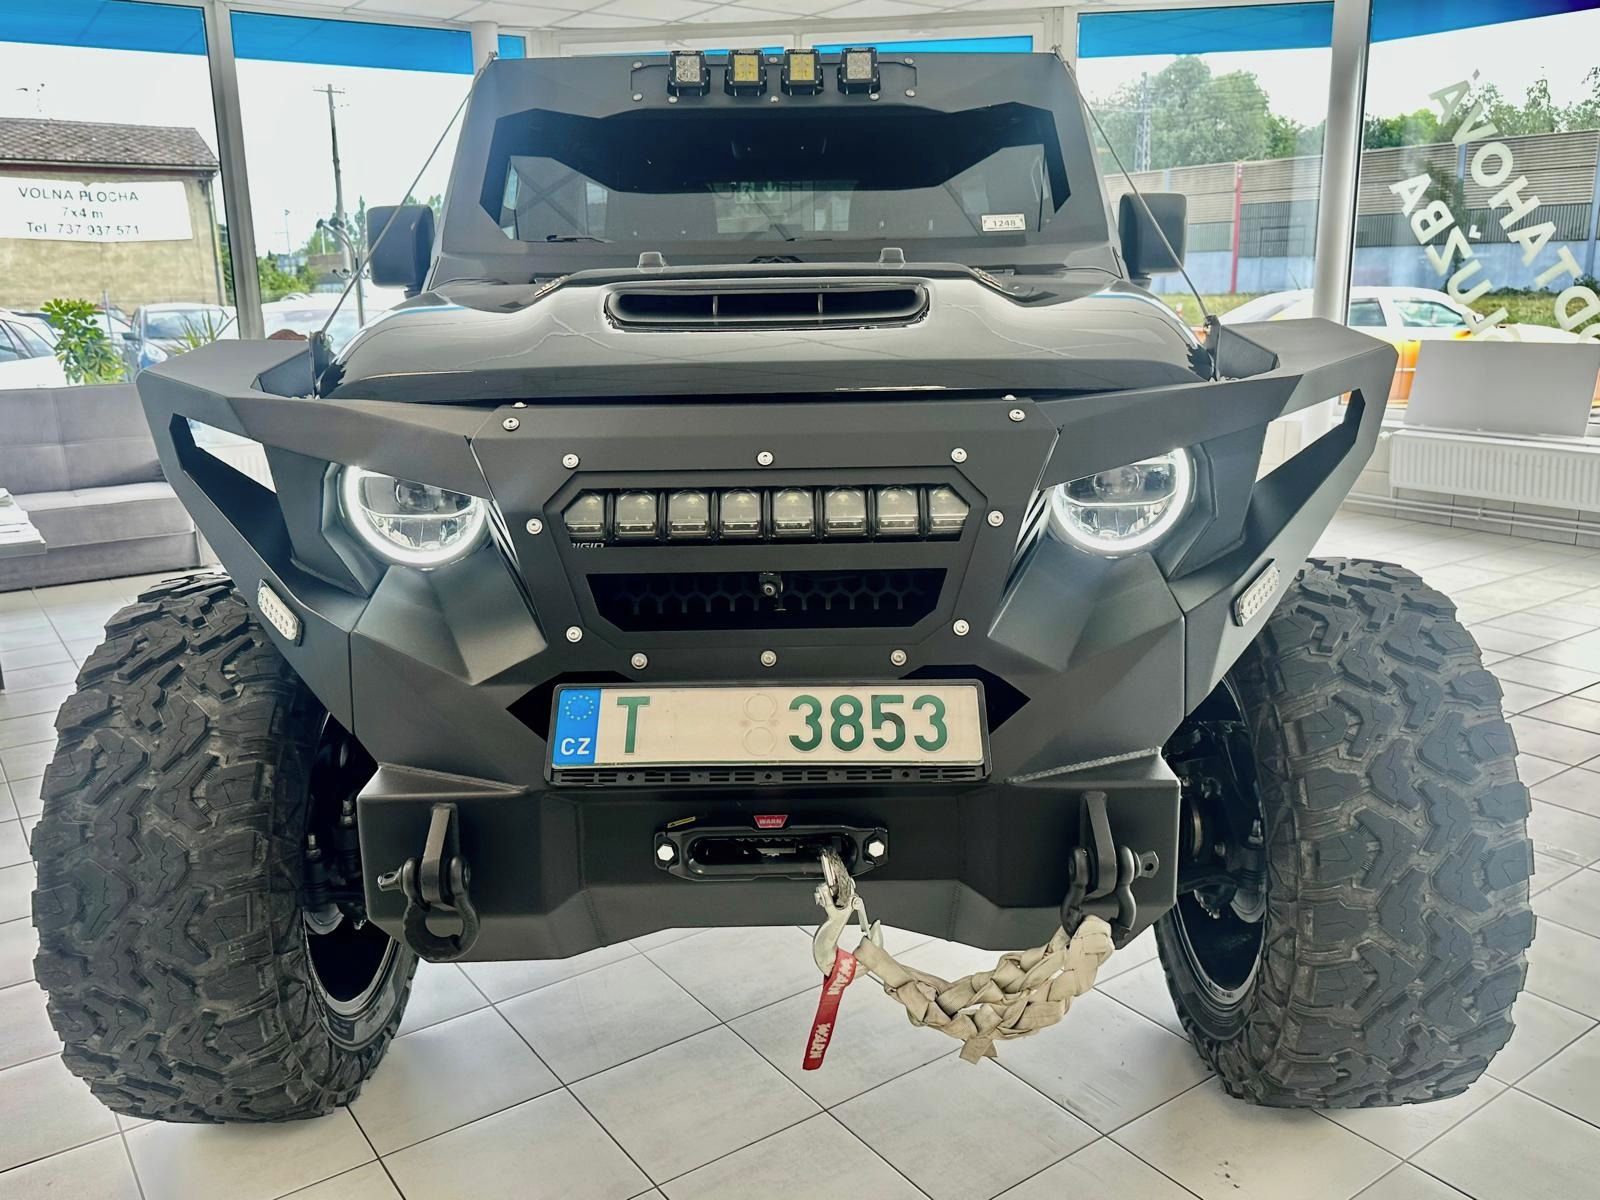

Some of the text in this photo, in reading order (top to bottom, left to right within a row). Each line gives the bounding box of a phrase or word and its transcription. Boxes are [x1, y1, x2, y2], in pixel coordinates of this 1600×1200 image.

[18, 186, 139, 203] VOLNA PLOCHA
[57, 223, 81, 235] 737
[87, 225, 111, 236] 937
[116, 225, 140, 236] 571
[560, 694, 948, 756] CZ T 3853
[827, 957, 854, 996] WARN
[808, 1022, 832, 1060] WARN
